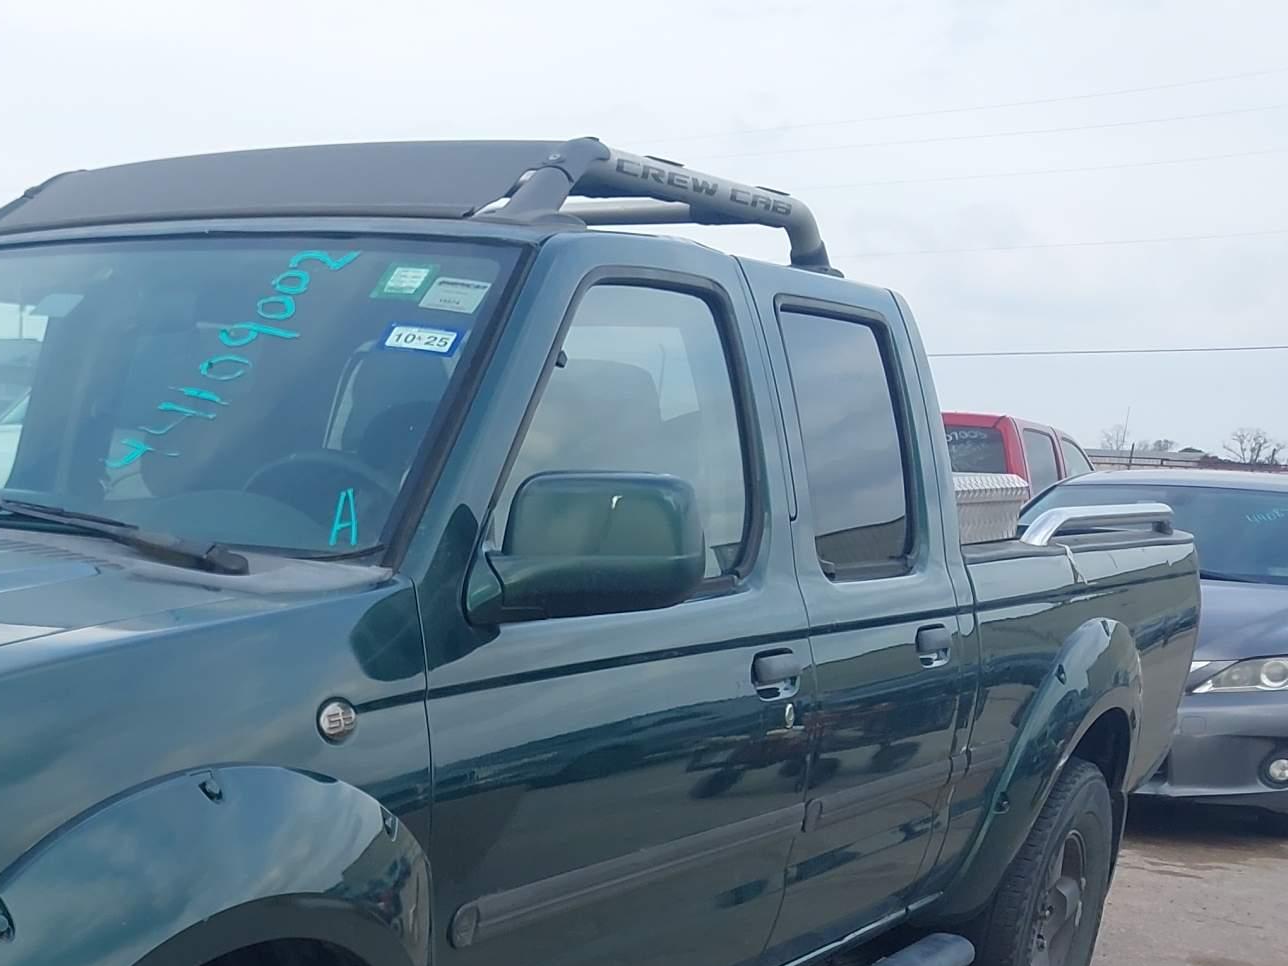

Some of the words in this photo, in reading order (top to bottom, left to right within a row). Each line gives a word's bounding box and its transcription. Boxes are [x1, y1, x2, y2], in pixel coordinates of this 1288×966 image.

[615, 158, 719, 196] CREW
[729, 187, 793, 216] CAB
[394, 332, 417, 344] 10
[423, 335, 450, 348] 25
[329, 488, 358, 546] A
